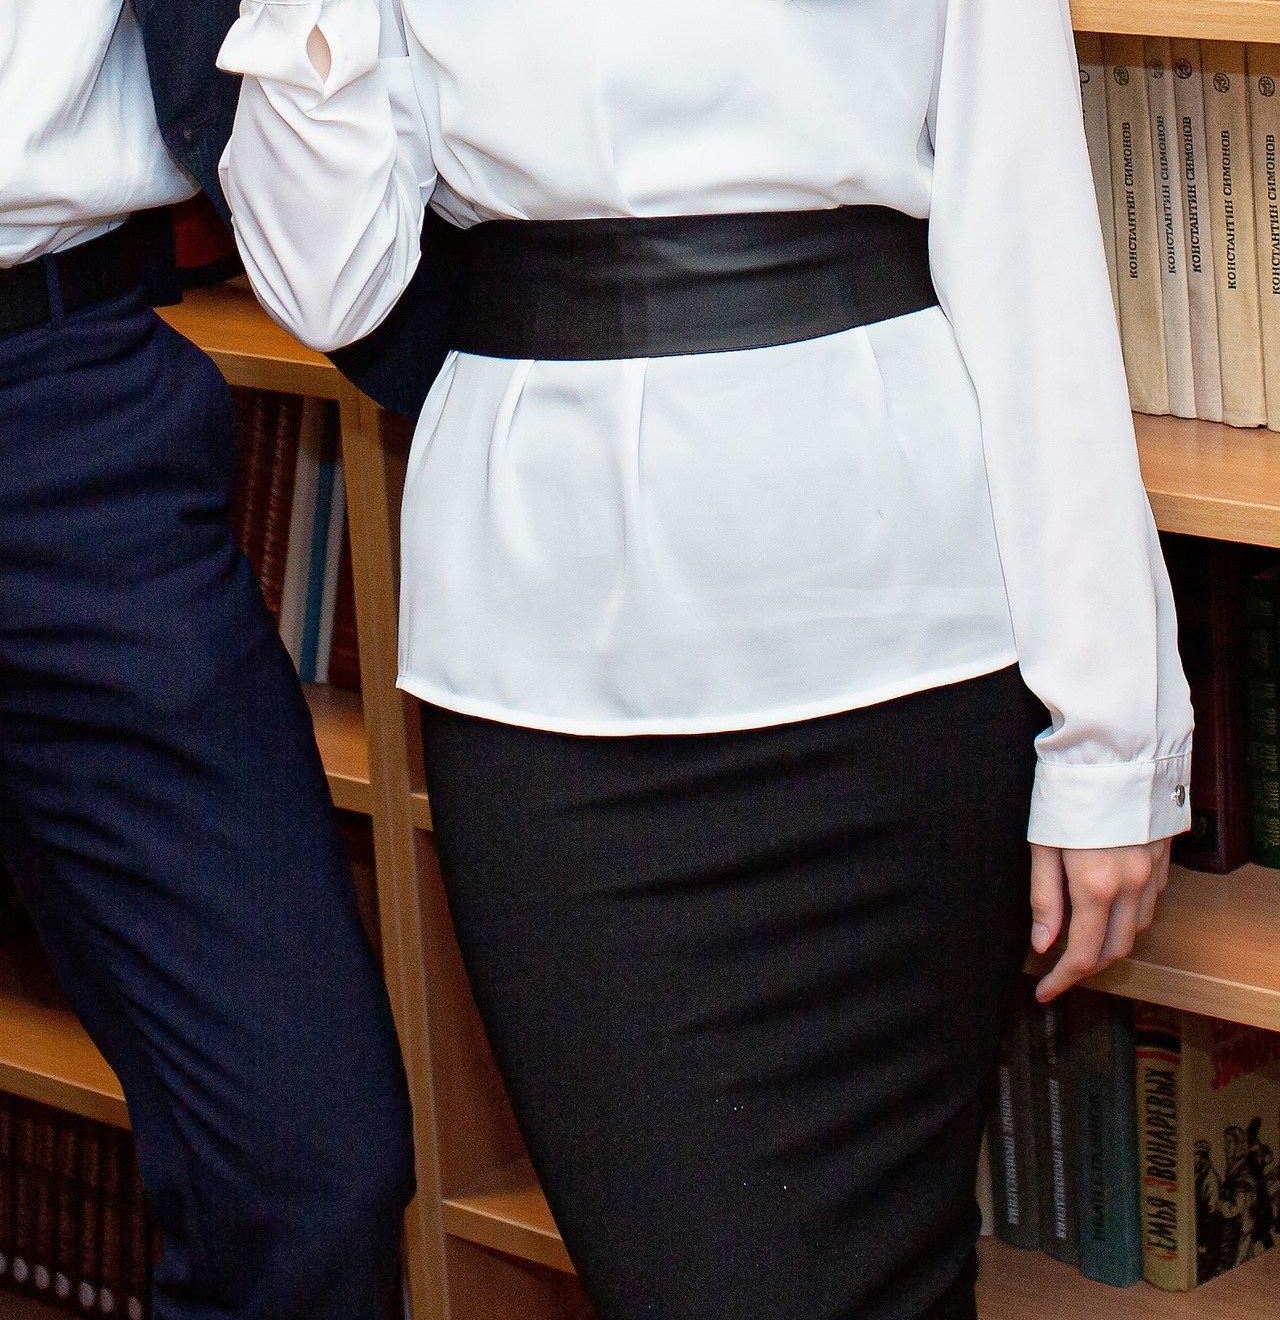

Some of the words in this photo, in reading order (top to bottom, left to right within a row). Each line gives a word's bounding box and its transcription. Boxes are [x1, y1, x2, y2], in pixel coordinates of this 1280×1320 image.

[1122, 121, 1134, 187] СИМОНОВ
[1156, 115, 1169, 180] СИМОНОВ
[1182, 116, 1195, 181] СИМОНОВ
[1220, 130, 1233, 197] СИМОНОВ
[1265, 134, 1277, 201] СИМОНОВ
[1125, 190, 1138, 280] КОНСТАНТИН
[1162, 184, 1176, 274] КОНСТАНТИН
[1187, 184, 1202, 273] КОНСТАНТИН
[1224, 199, 1237, 290] КОНСТАНТИН
[1269, 204, 1280, 296] КОНСТАНТИН
[1144, 1067, 1179, 1193] ЗВОНАРЕВЫХ
[1145, 1195, 1179, 1261] СЕМЬЯ
